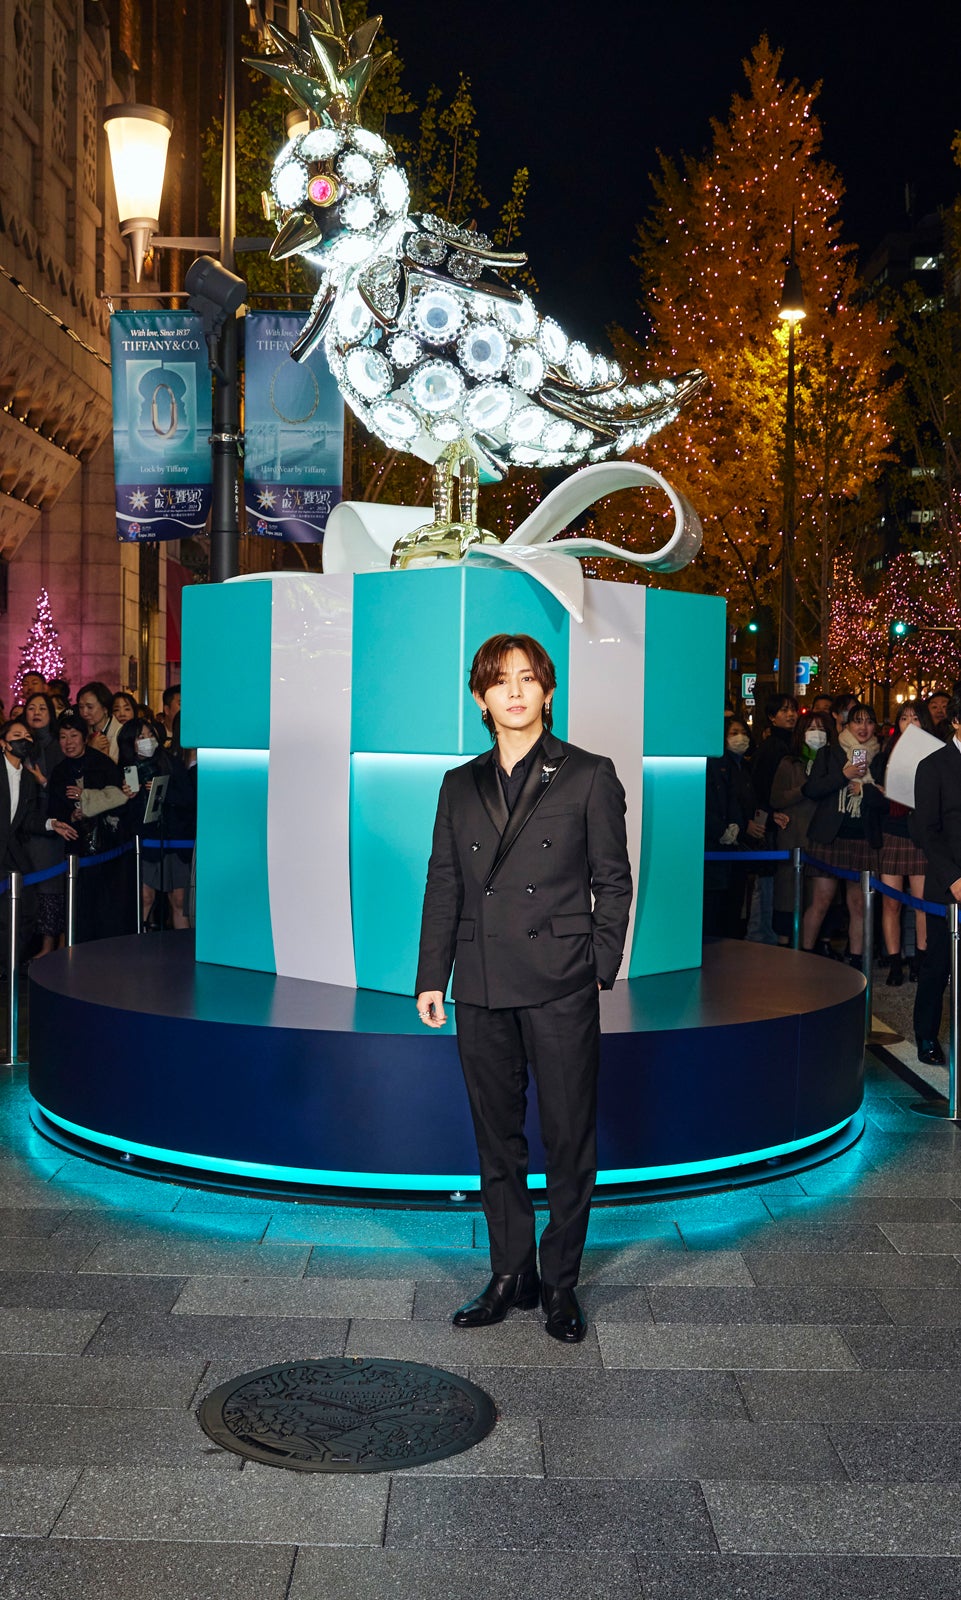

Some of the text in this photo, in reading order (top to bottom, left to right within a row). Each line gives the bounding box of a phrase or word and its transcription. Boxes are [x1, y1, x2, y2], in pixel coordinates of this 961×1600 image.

[130, 328, 191, 338] With love, Since 1837
[265, 329, 281, 337] With
[121, 339, 201, 351] TIFFANY&CO.
[140, 464, 189, 475] Lock by Tiffany
[295, 465, 303, 475] by
[304, 465, 328, 475] Tiffany
